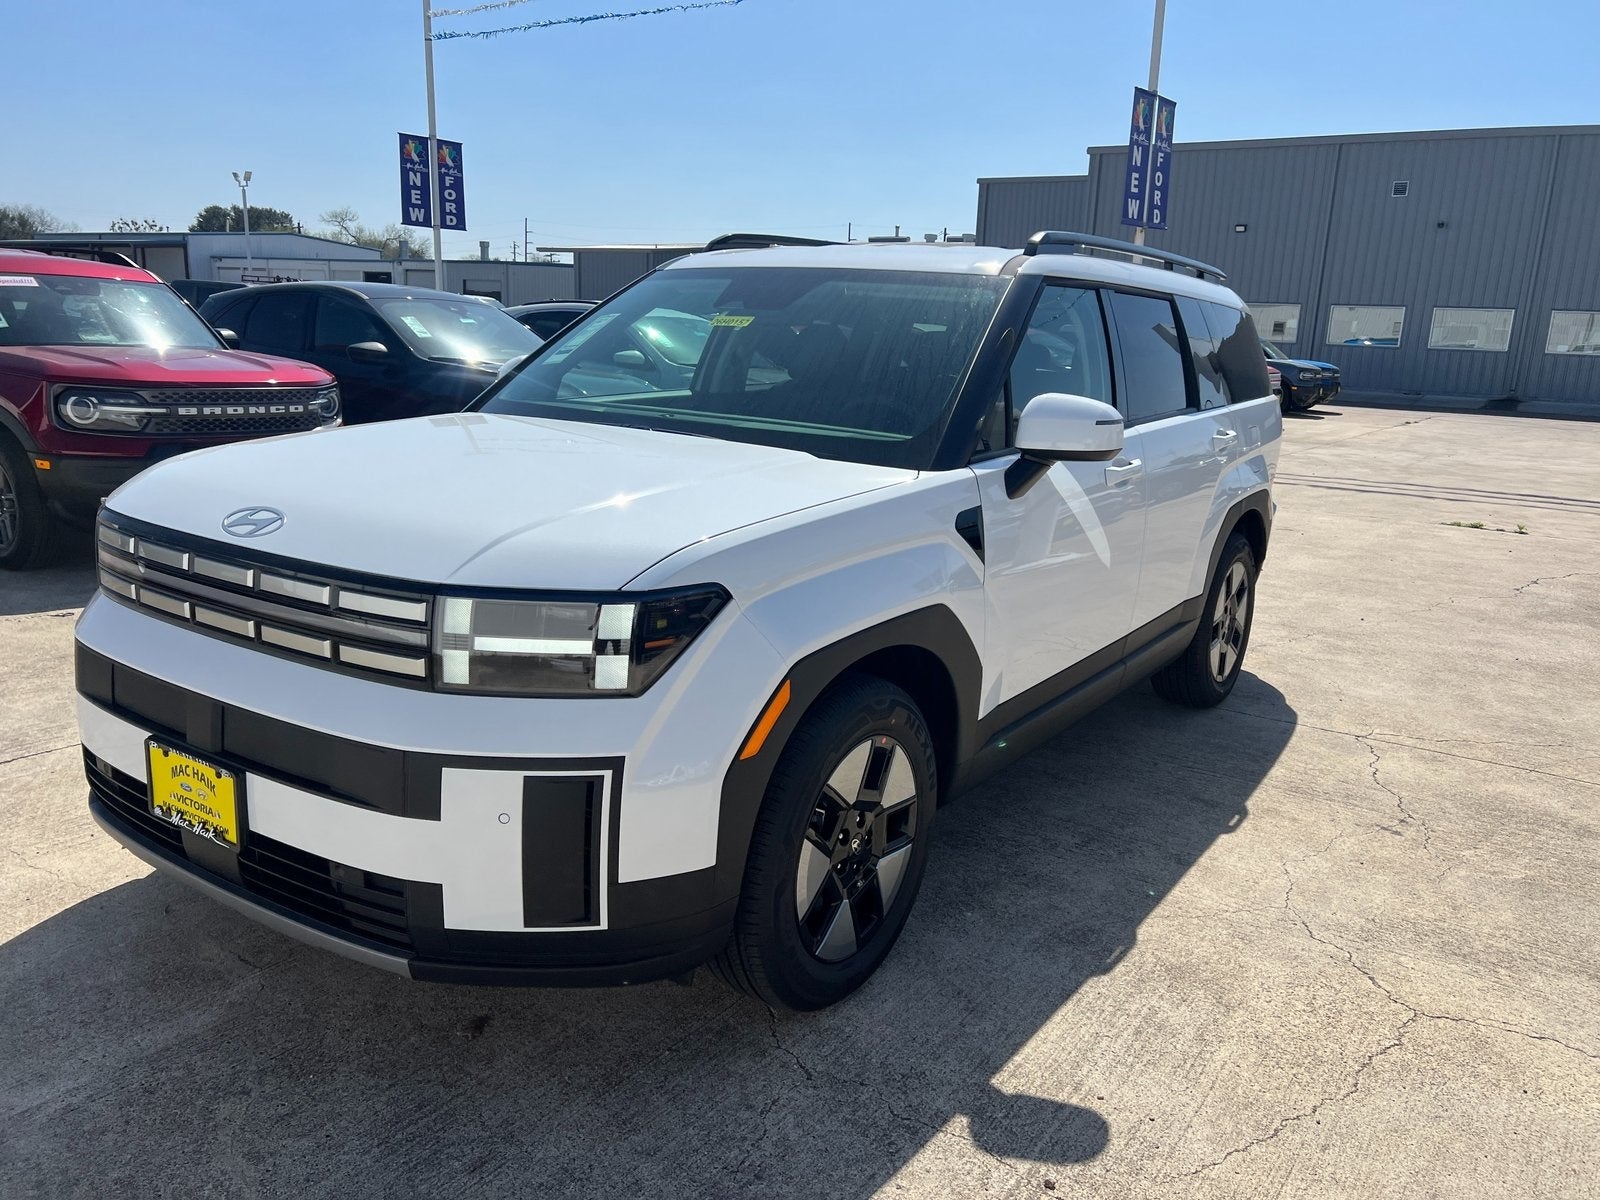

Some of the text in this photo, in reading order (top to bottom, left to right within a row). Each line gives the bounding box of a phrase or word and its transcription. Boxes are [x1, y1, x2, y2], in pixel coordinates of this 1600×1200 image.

[408, 171, 425, 222] NEW
[444, 176, 457, 226] FORD
[1127, 145, 1142, 219] NEW
[1153, 152, 1165, 224] FORD
[178, 405, 303, 415] BRONCO
[171, 764, 191, 779] MAC
[192, 766, 217, 797] HAIK
[176, 793, 214, 817] VICTORIA
[168, 811, 224, 845] Mac Haik
